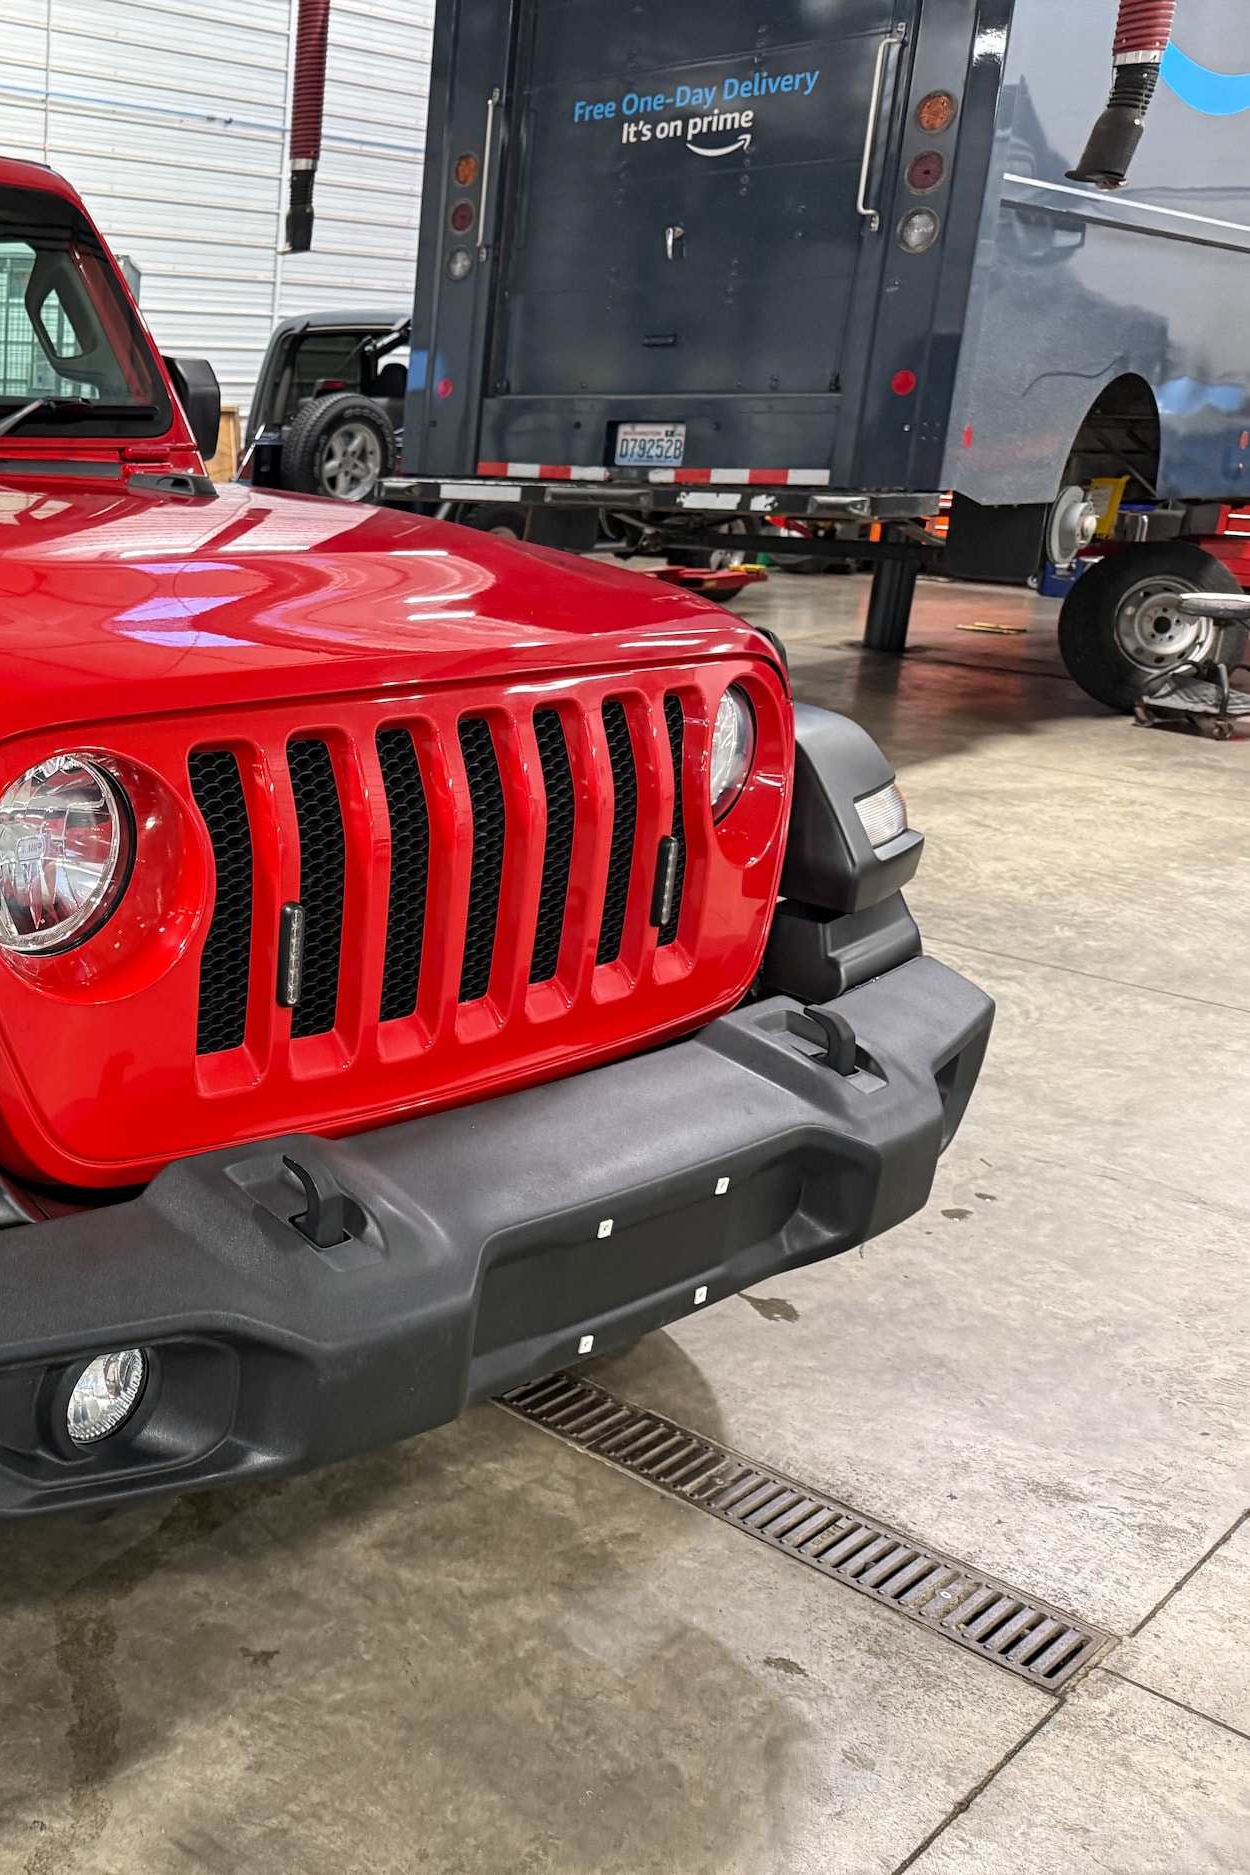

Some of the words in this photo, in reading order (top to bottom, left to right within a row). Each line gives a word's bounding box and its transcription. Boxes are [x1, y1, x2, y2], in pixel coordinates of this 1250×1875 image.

[574, 101, 616, 123] Free
[622, 85, 717, 116] One-Day
[723, 70, 820, 101] Delivery
[622, 120, 651, 144] It's
[656, 119, 682, 139] on
[687, 108, 754, 140] prime
[619, 438, 683, 460] D79252B
